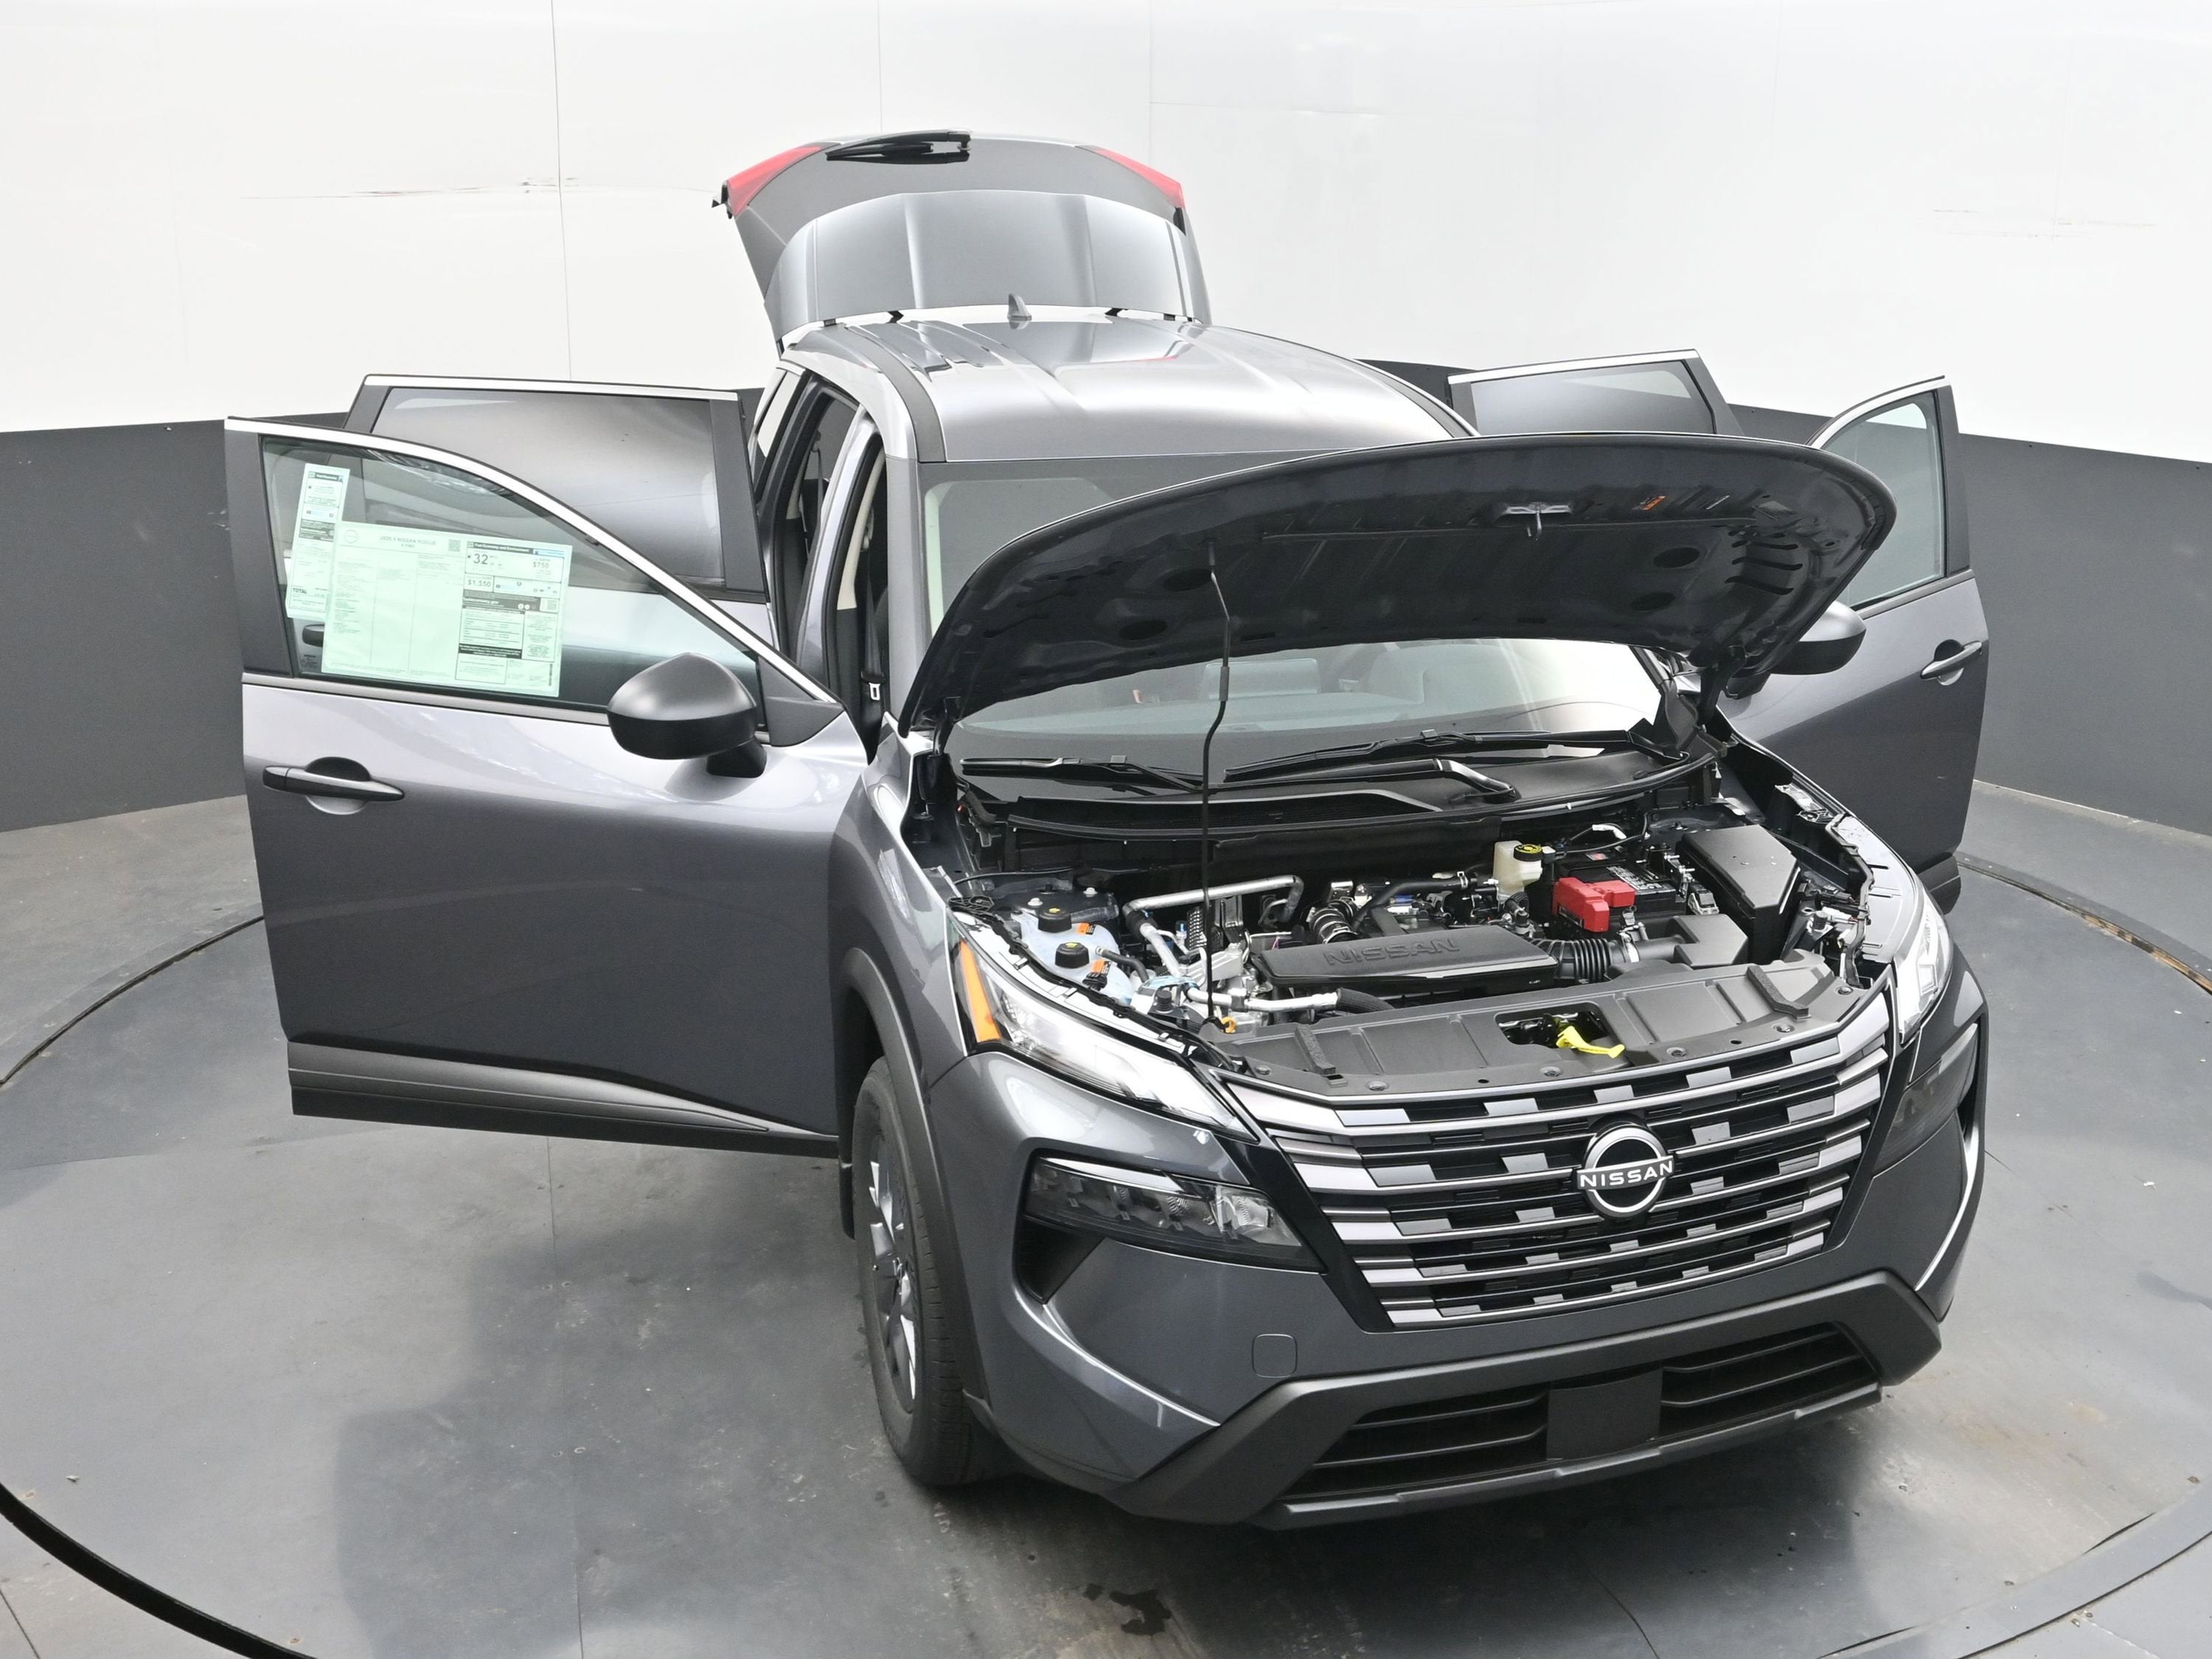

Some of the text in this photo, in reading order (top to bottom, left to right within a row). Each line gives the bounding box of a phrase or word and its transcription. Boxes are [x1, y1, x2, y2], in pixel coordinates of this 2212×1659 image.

[473, 553, 488, 565] 32
[1324, 938, 1460, 966] NISSAN
[1580, 1160, 1673, 1187] NISSAN
